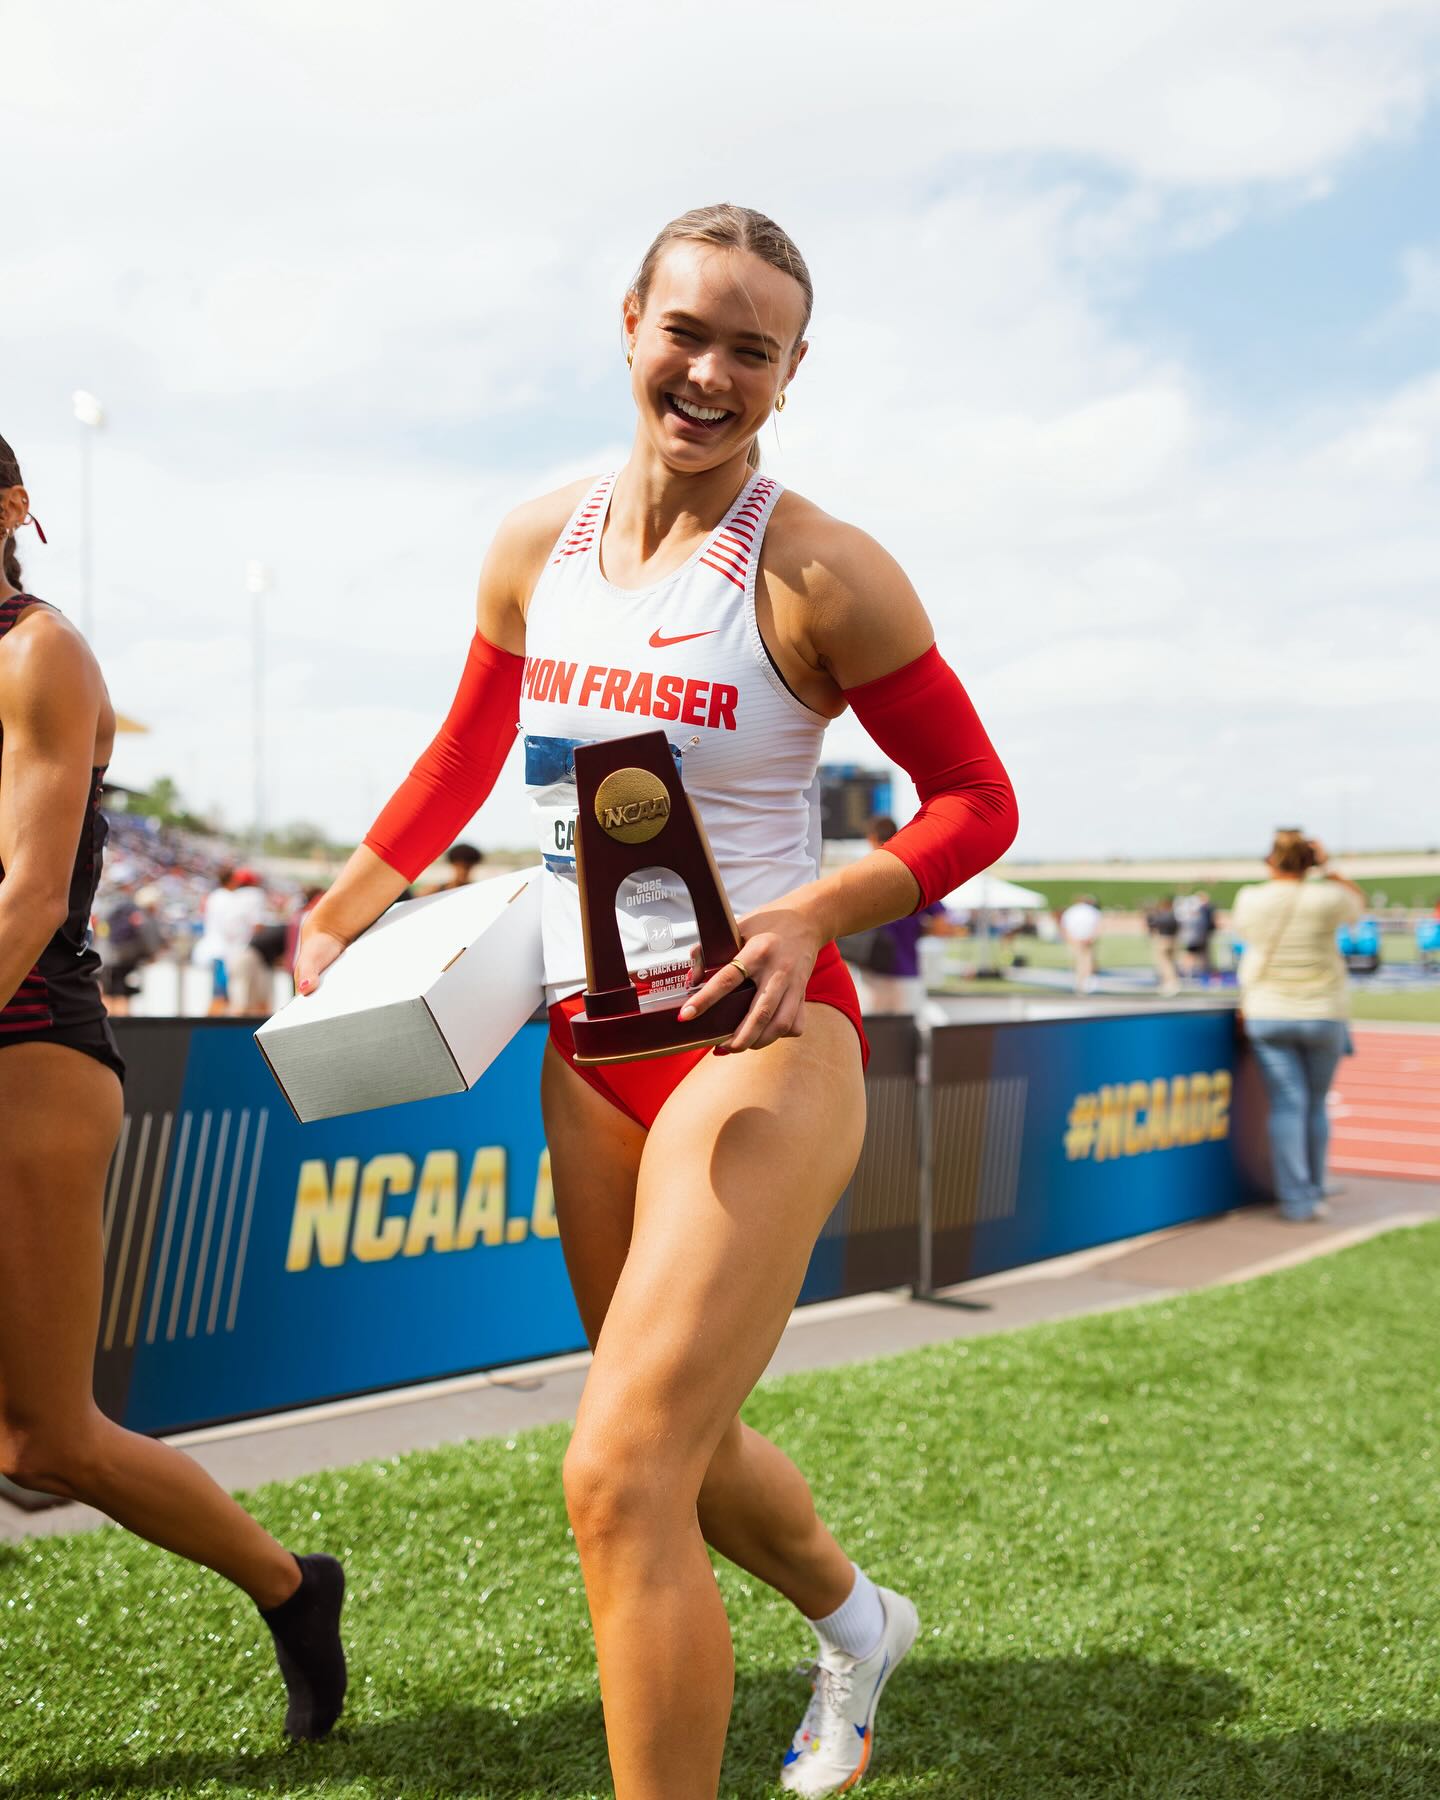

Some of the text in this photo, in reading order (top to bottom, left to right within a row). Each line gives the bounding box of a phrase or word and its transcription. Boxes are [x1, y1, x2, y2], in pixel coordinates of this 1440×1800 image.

[578, 665, 739, 731] FRASER
[604, 796, 669, 829] NCAA
[626, 888, 668, 907] DIVISION
[636, 879, 662, 894] 2025
[648, 963, 671, 976] TRACK
[1064, 1070, 1231, 1163] #NCAAD2
